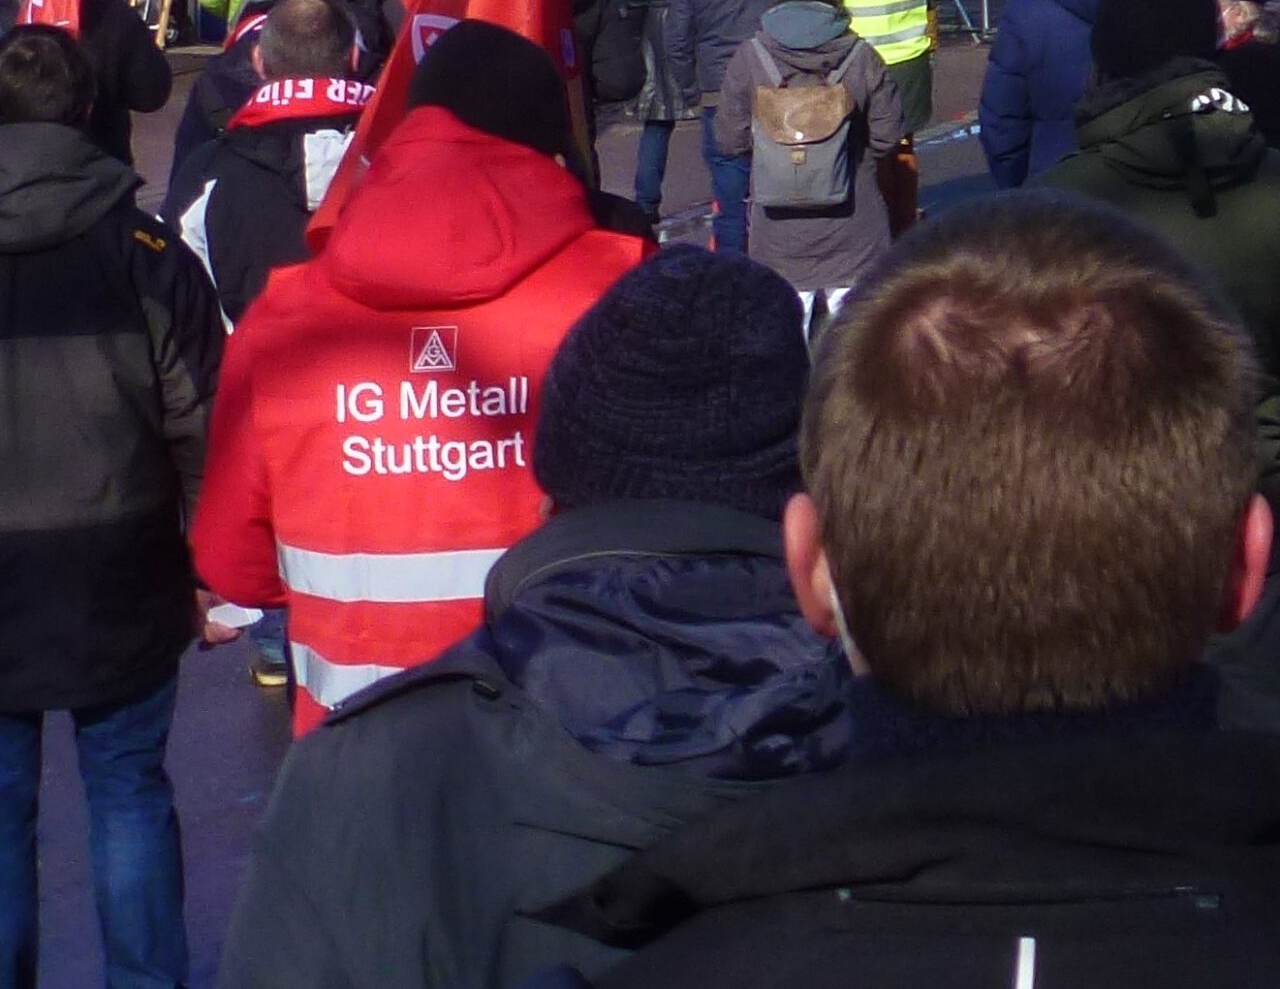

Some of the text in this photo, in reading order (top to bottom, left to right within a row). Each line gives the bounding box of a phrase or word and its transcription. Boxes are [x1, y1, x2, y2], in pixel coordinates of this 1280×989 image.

[336, 377, 528, 423] IG Metall
[342, 431, 526, 481] Stuttgart
